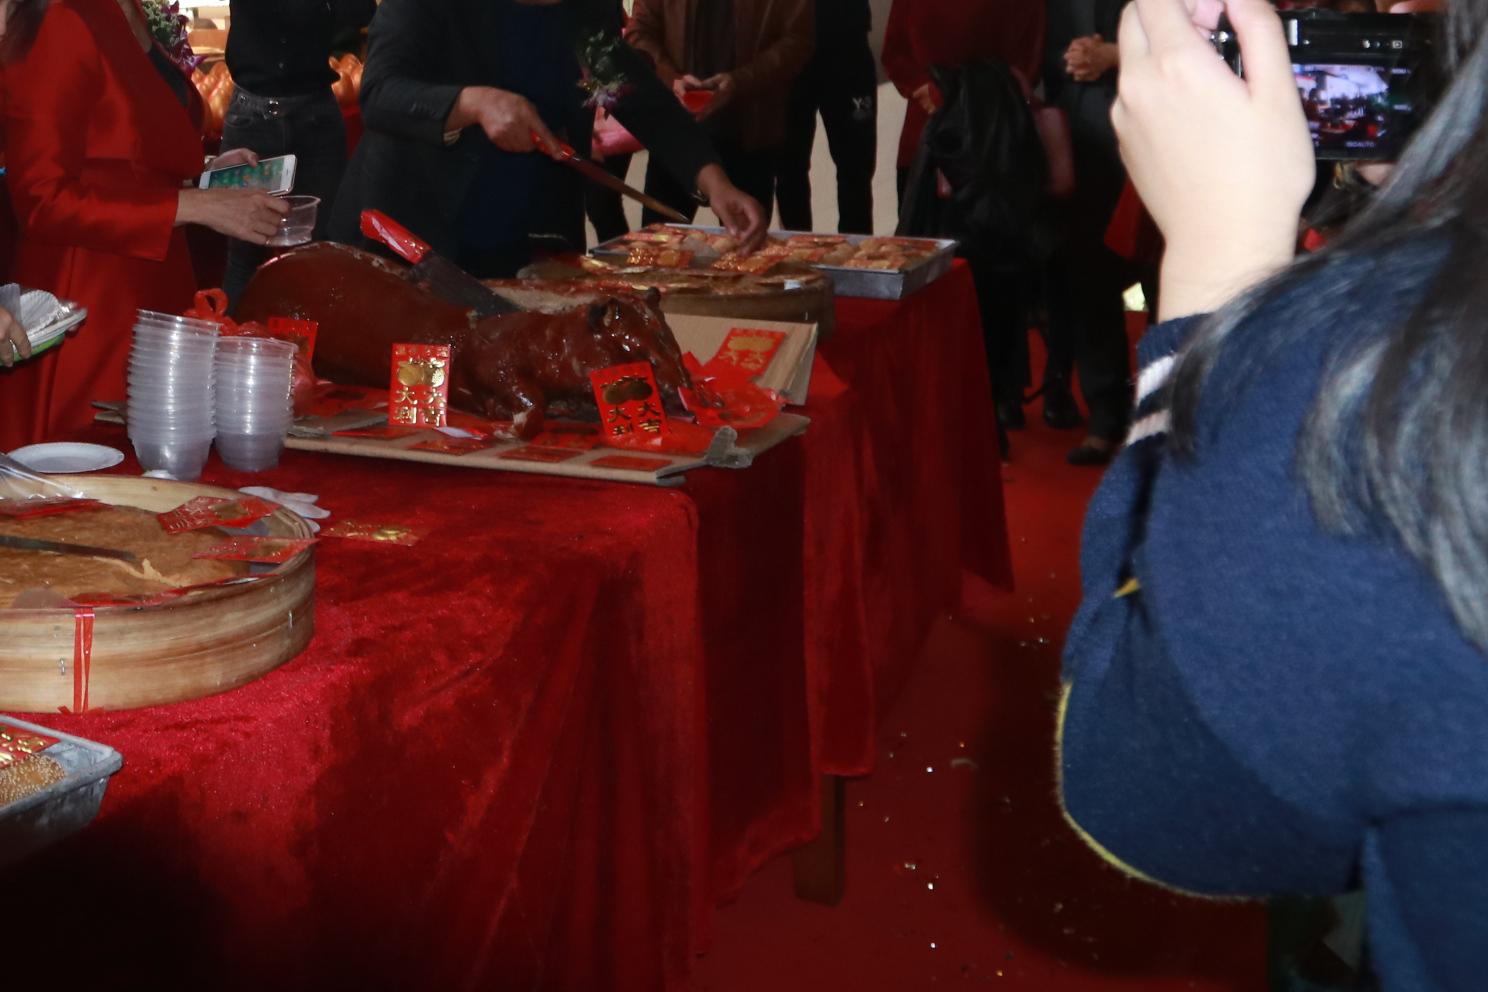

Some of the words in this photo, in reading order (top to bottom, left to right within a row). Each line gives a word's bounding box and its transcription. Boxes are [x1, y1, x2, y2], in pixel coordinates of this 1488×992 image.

[393, 385, 418, 424] 大利
[419, 386, 447, 427] 大吉
[637, 399, 662, 434] 大吉
